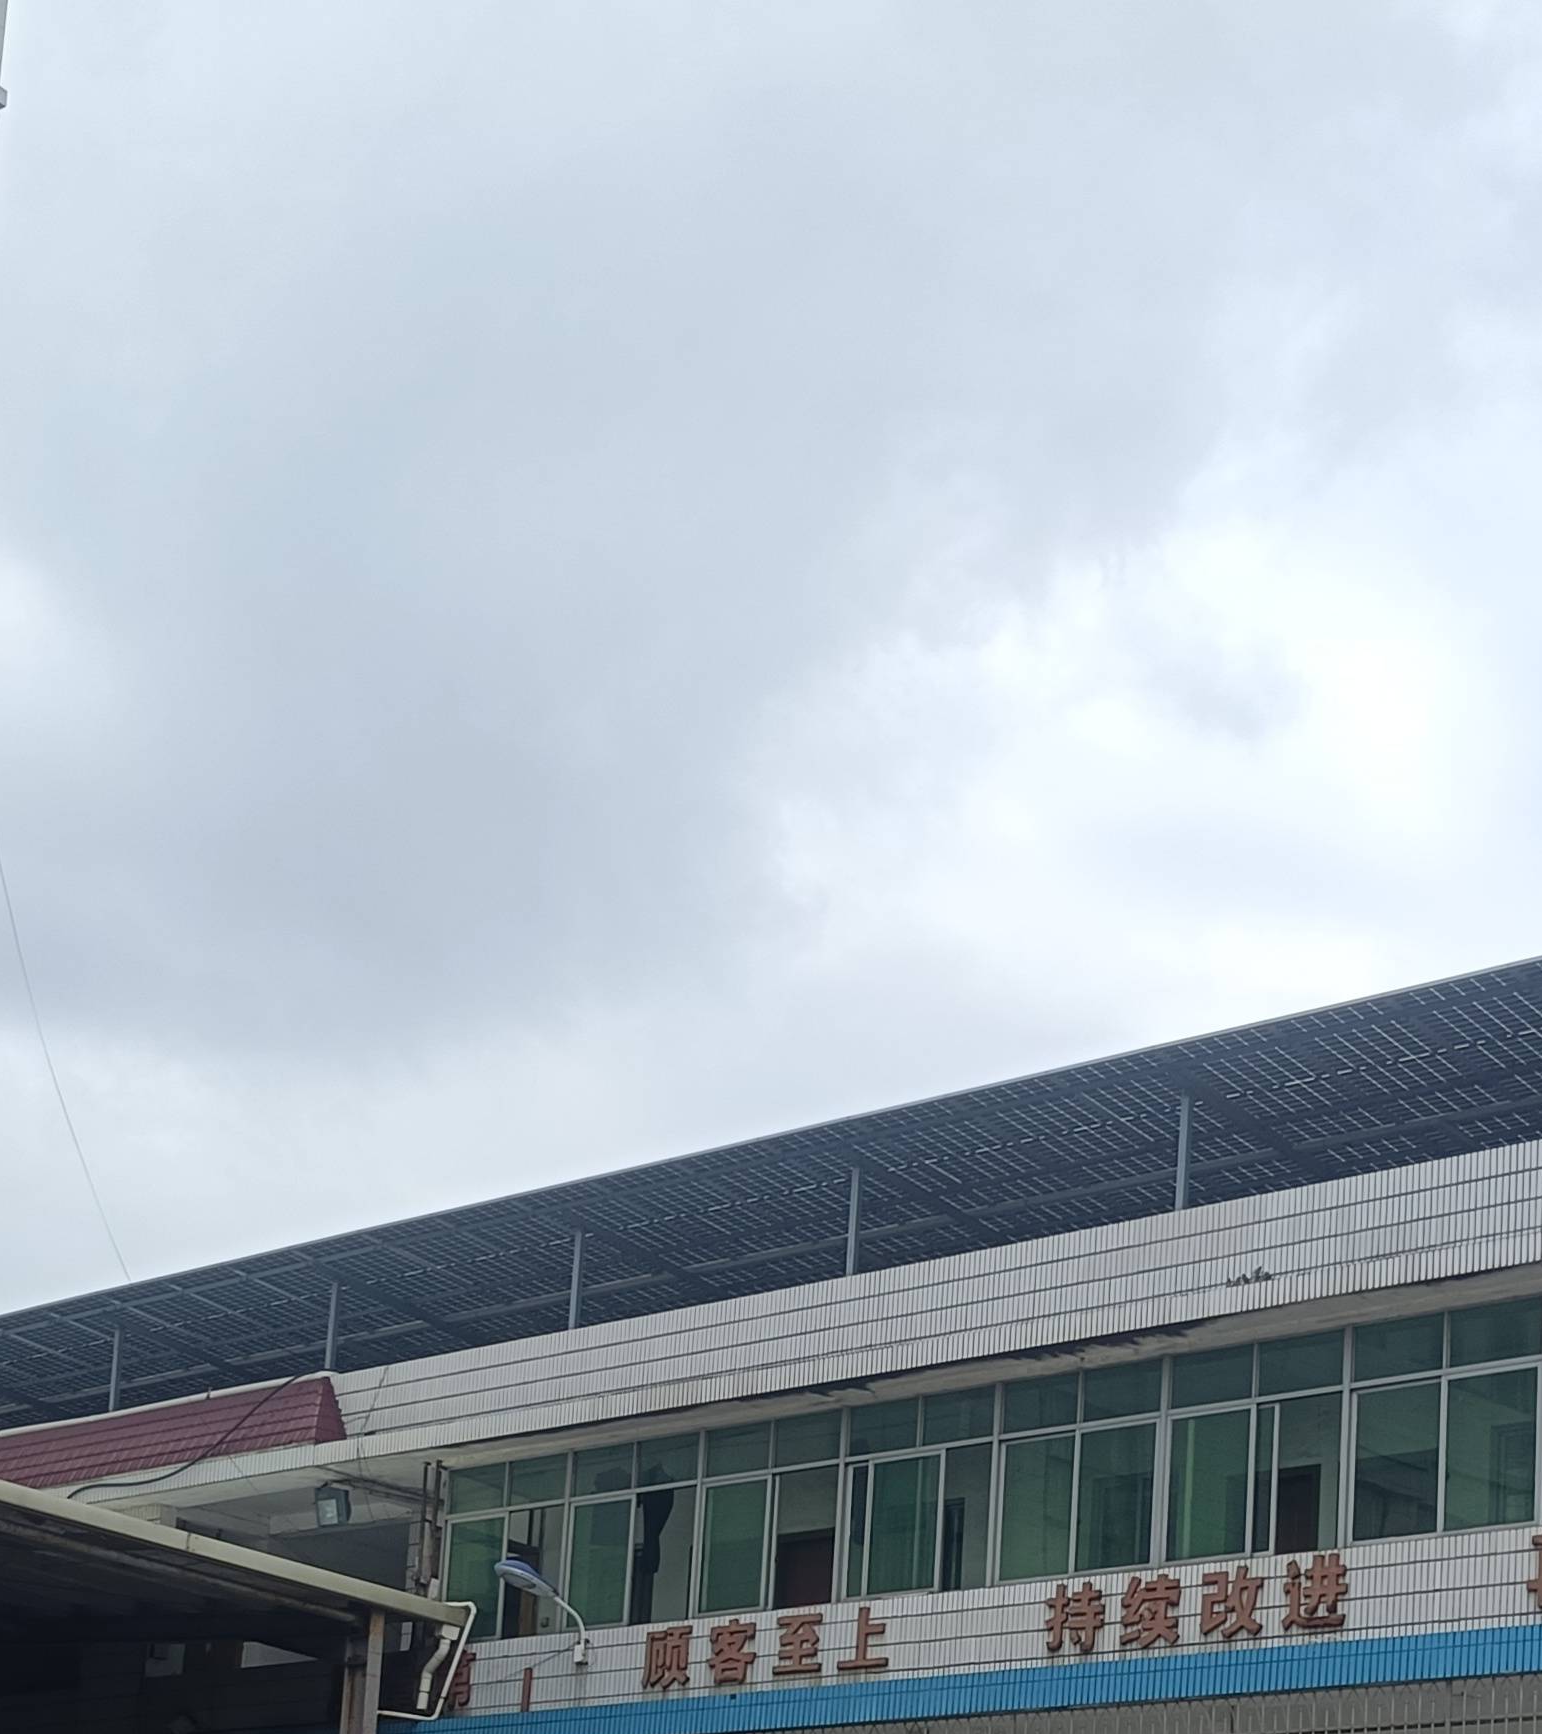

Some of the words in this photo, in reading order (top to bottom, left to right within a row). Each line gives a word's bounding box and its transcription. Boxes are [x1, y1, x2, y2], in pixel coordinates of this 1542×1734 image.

[640, 1606, 890, 1691] 顾客至上
[1044, 1553, 1350, 1655] 持续改进
